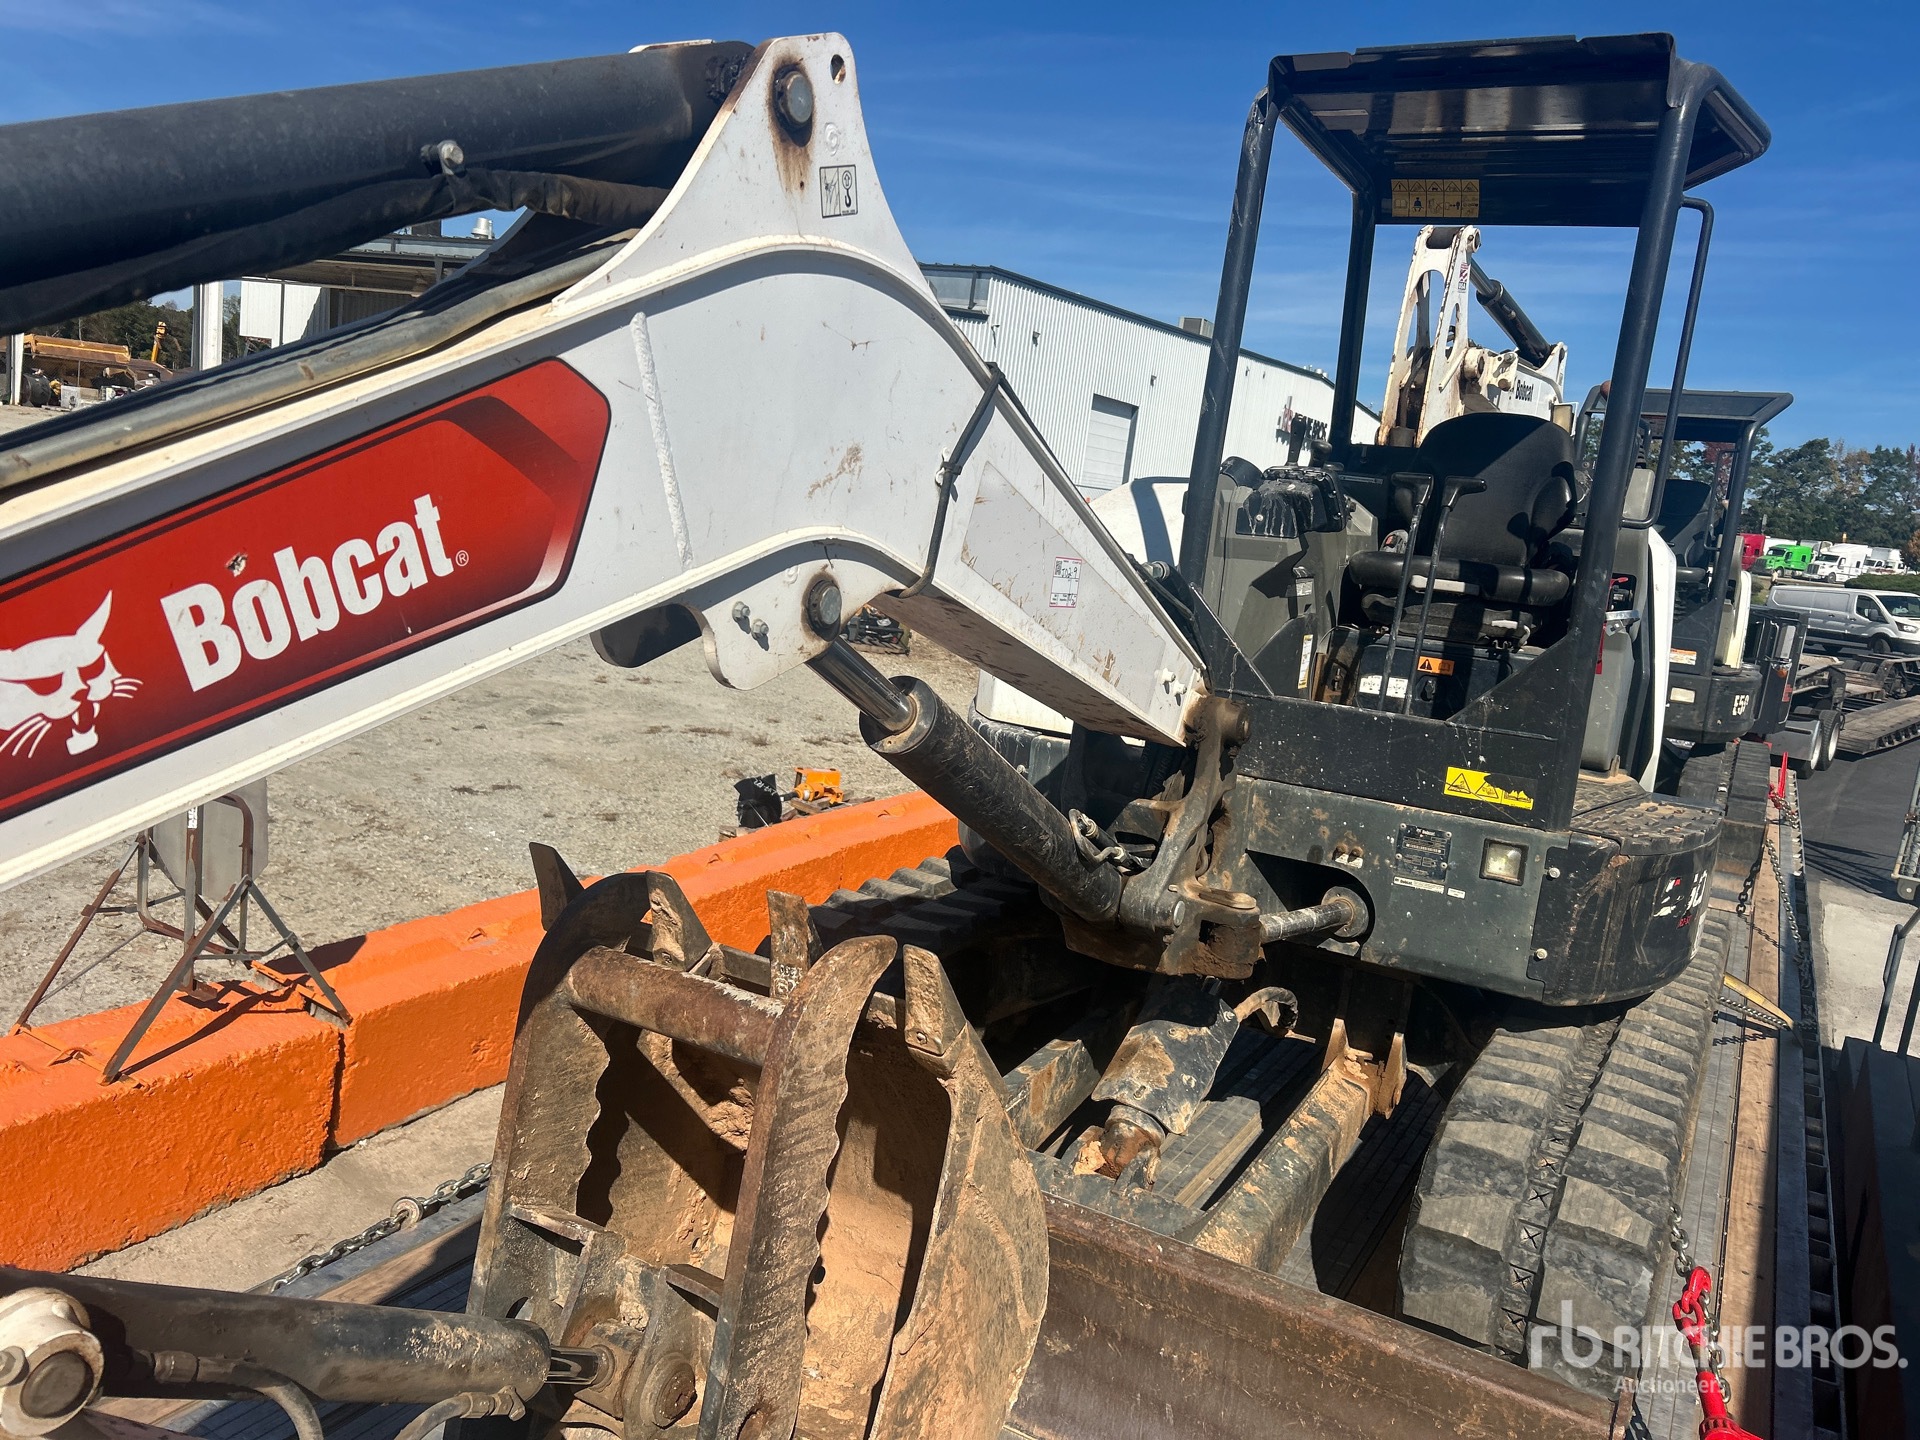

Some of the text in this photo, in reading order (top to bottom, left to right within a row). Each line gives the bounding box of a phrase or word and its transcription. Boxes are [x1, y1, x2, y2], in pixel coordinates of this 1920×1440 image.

[1515, 379, 1534, 402] Bobcat
[160, 494, 454, 692] Bobcat
[1732, 694, 1750, 716] E50
